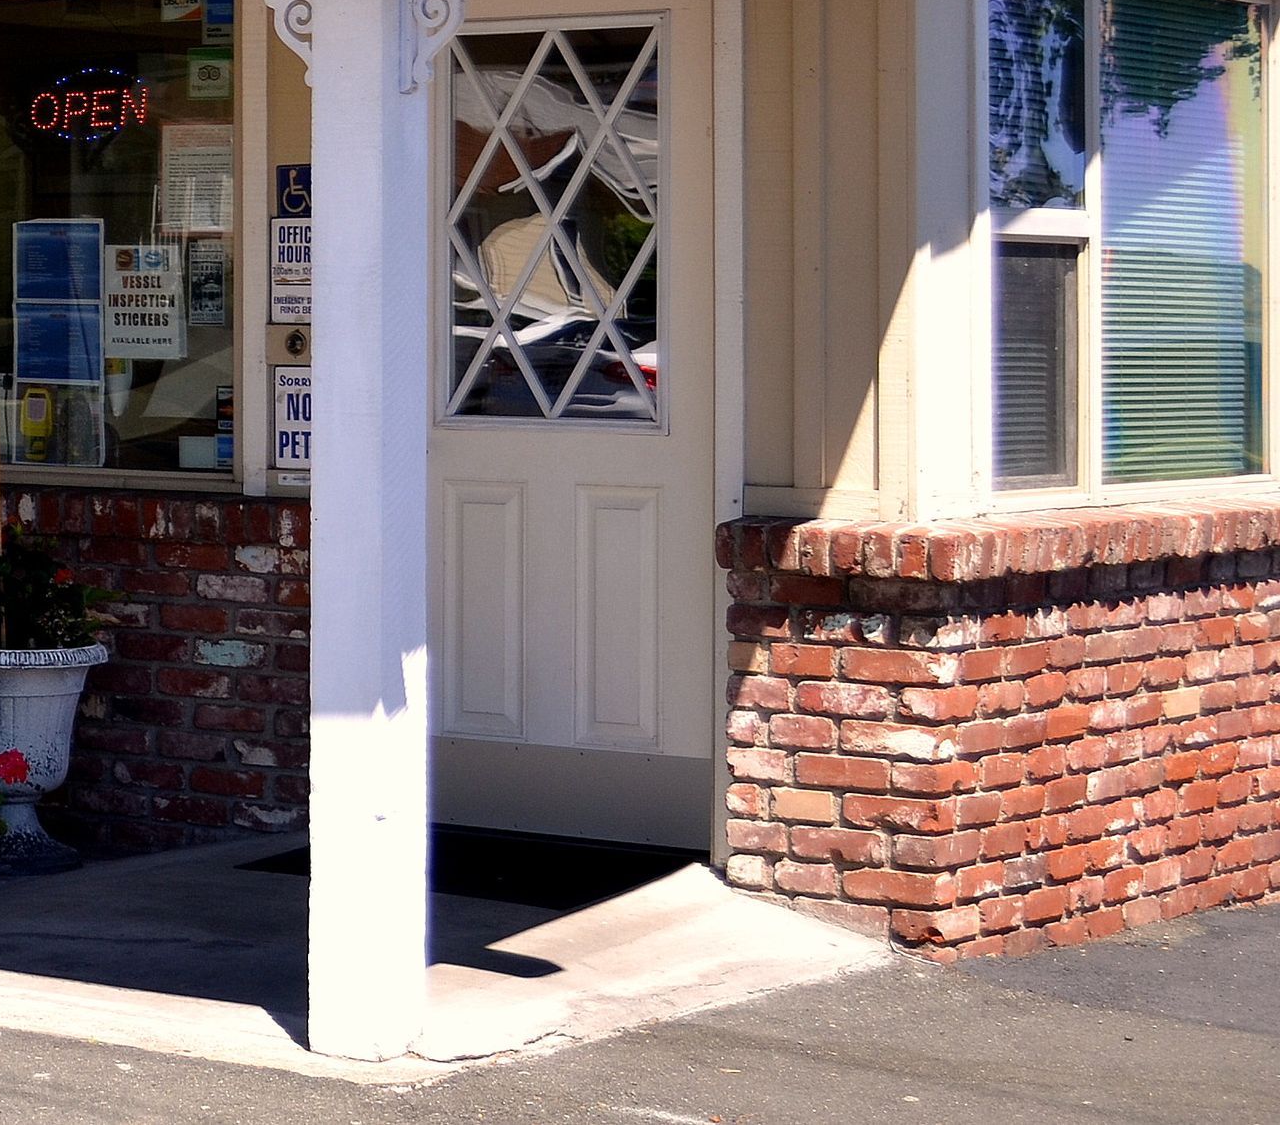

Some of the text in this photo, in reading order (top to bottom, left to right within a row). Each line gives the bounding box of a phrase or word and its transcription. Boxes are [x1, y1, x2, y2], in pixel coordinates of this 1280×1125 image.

[30, 87, 148, 130] OPEN
[278, 226, 312, 244] OFFIC
[278, 245, 312, 263] HOUR
[122, 276, 162, 289] VESSEL
[108, 294, 175, 308] INSPECTION
[280, 306, 300, 314] RING
[114, 313, 169, 327] STICKERS
[112, 337, 172, 345] AVAILABLE HERE
[287, 393, 312, 422] NO
[279, 431, 312, 459] PET
